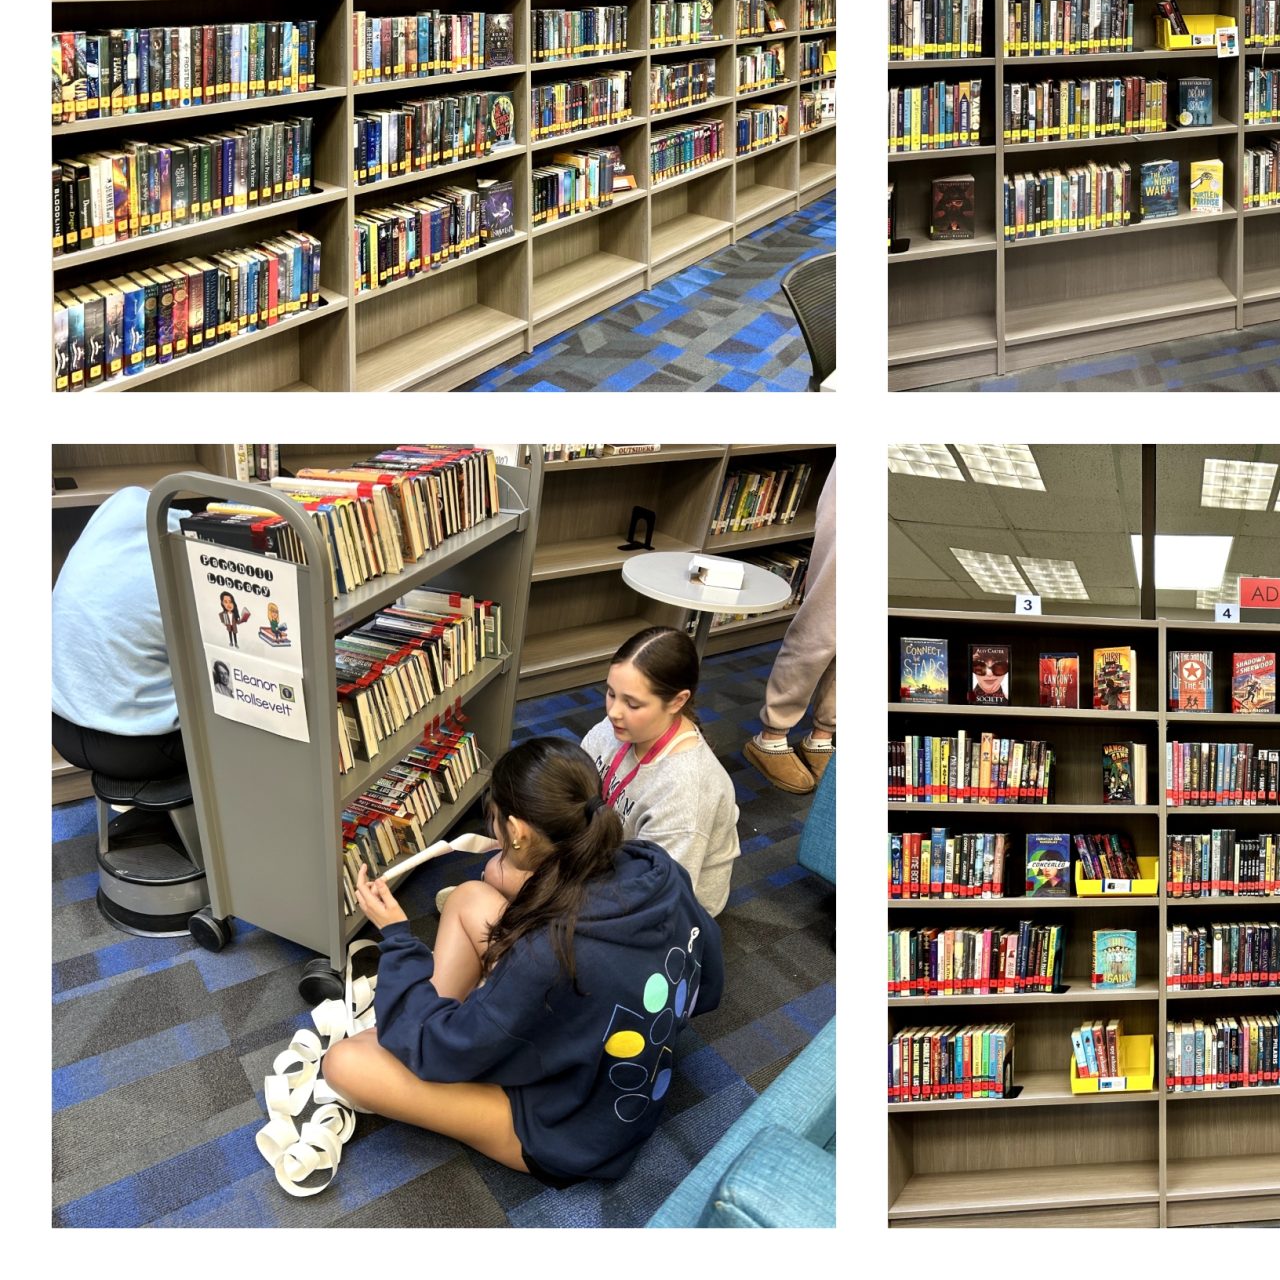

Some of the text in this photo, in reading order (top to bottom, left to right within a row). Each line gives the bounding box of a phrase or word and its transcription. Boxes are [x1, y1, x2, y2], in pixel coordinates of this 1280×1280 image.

[1153, 176, 1176, 186] NIGHT
[1145, 185, 1166, 197] WAR
[618, 446, 655, 454] OUTSIDERS
[1023, 599, 1033, 611] 3
[1222, 608, 1232, 619] 4
[905, 644, 941, 656] CONNECT
[1236, 656, 1266, 668] SHADOWS
[1239, 660, 1274, 674] SHERWOOD
[903, 658, 945, 680] STARS
[233, 668, 277, 693] Eleanor
[1050, 686, 1067, 699] EDGE
[976, 695, 1004, 703] SOCIETY
[1031, 860, 1066, 869] CONCEALED
